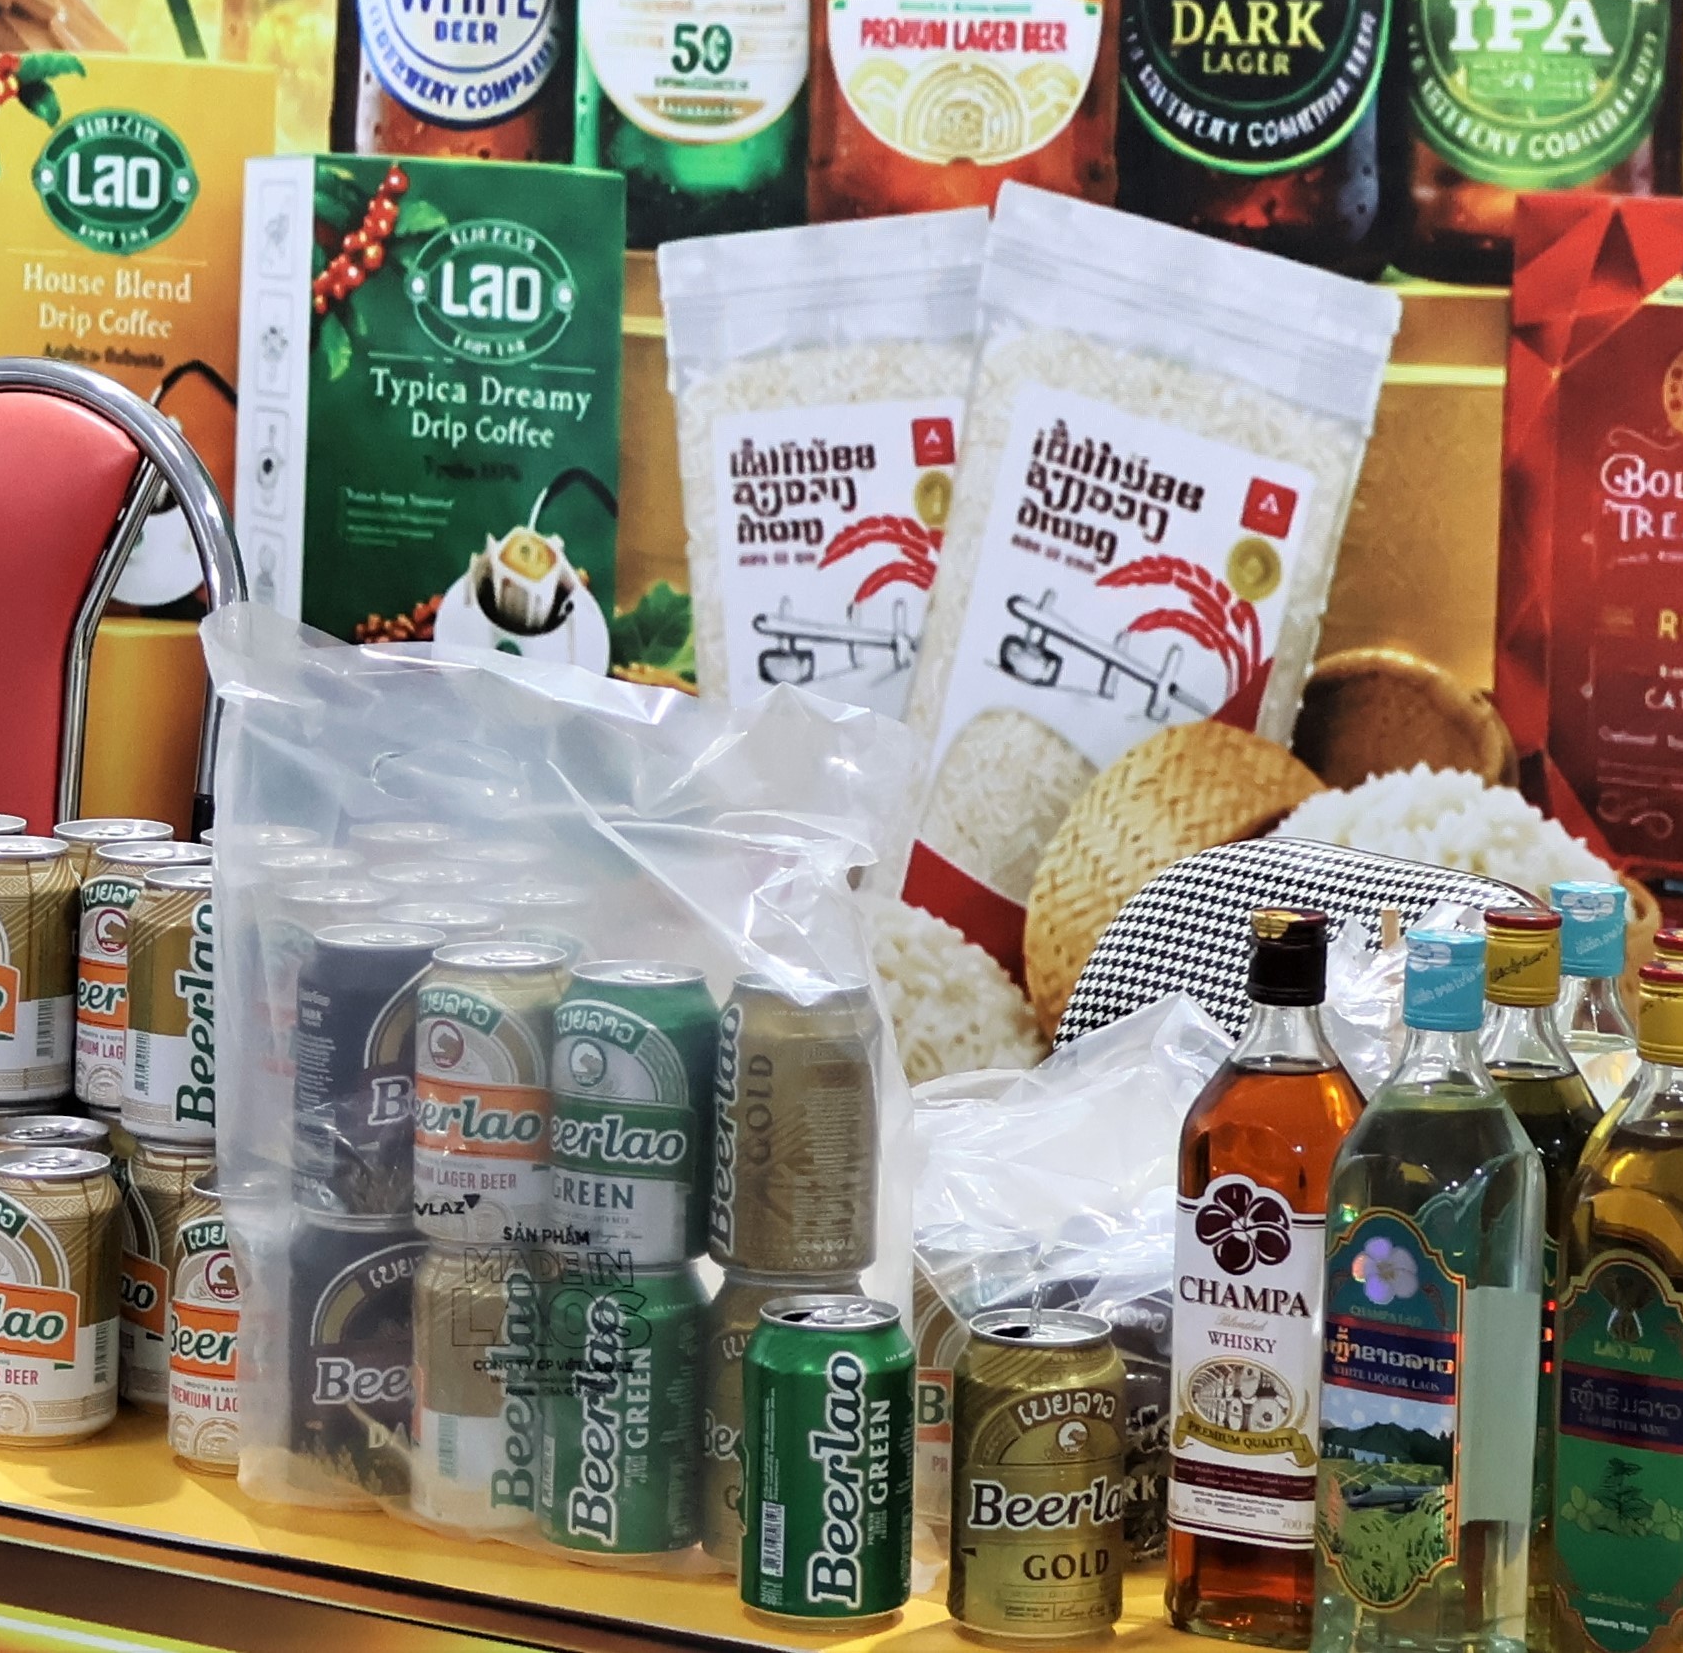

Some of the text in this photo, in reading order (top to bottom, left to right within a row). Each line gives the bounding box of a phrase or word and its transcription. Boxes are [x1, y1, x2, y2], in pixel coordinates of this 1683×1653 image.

[1201, 49, 1291, 76] LAGER
[66, 151, 162, 211] Lao
[22, 260, 193, 304] House Blend
[440, 260, 542, 323] Lao
[39, 303, 174, 339] Drip Coffee
[369, 367, 593, 422] Typica Dreamy
[411, 412, 556, 448] Drip Coffee
[744, 1052, 775, 1167] GOLD
[436, 1172, 517, 1191] LAGER BEER
[415, 1200, 466, 1217] VLAZ
[502, 1222, 591, 1246] SẢN PHẨM
[465, 1247, 635, 1288] MADE IN
[1178, 1275, 1312, 1319] CHAMPA
[451, 1287, 654, 1350] LAOS
[1206, 1330, 1278, 1355] WHISKY
[4, 1367, 39, 1387] BEER
[171, 1383, 212, 1410] PREMIUM
[624, 1345, 653, 1450] GREEN
[1367, 1372, 1409, 1388] LIQUOR
[1411, 1379, 1441, 1392] LAOS
[568, 1292, 625, 1546] Beerlao
[1187, 1420, 1294, 1450] PREMIUM QUALITY
[867, 1399, 892, 1505] GREEN
[806, 1349, 868, 1610] Beerlao
[968, 1475, 1124, 1531] Beerla
[1022, 1548, 1110, 1583] GOLD
